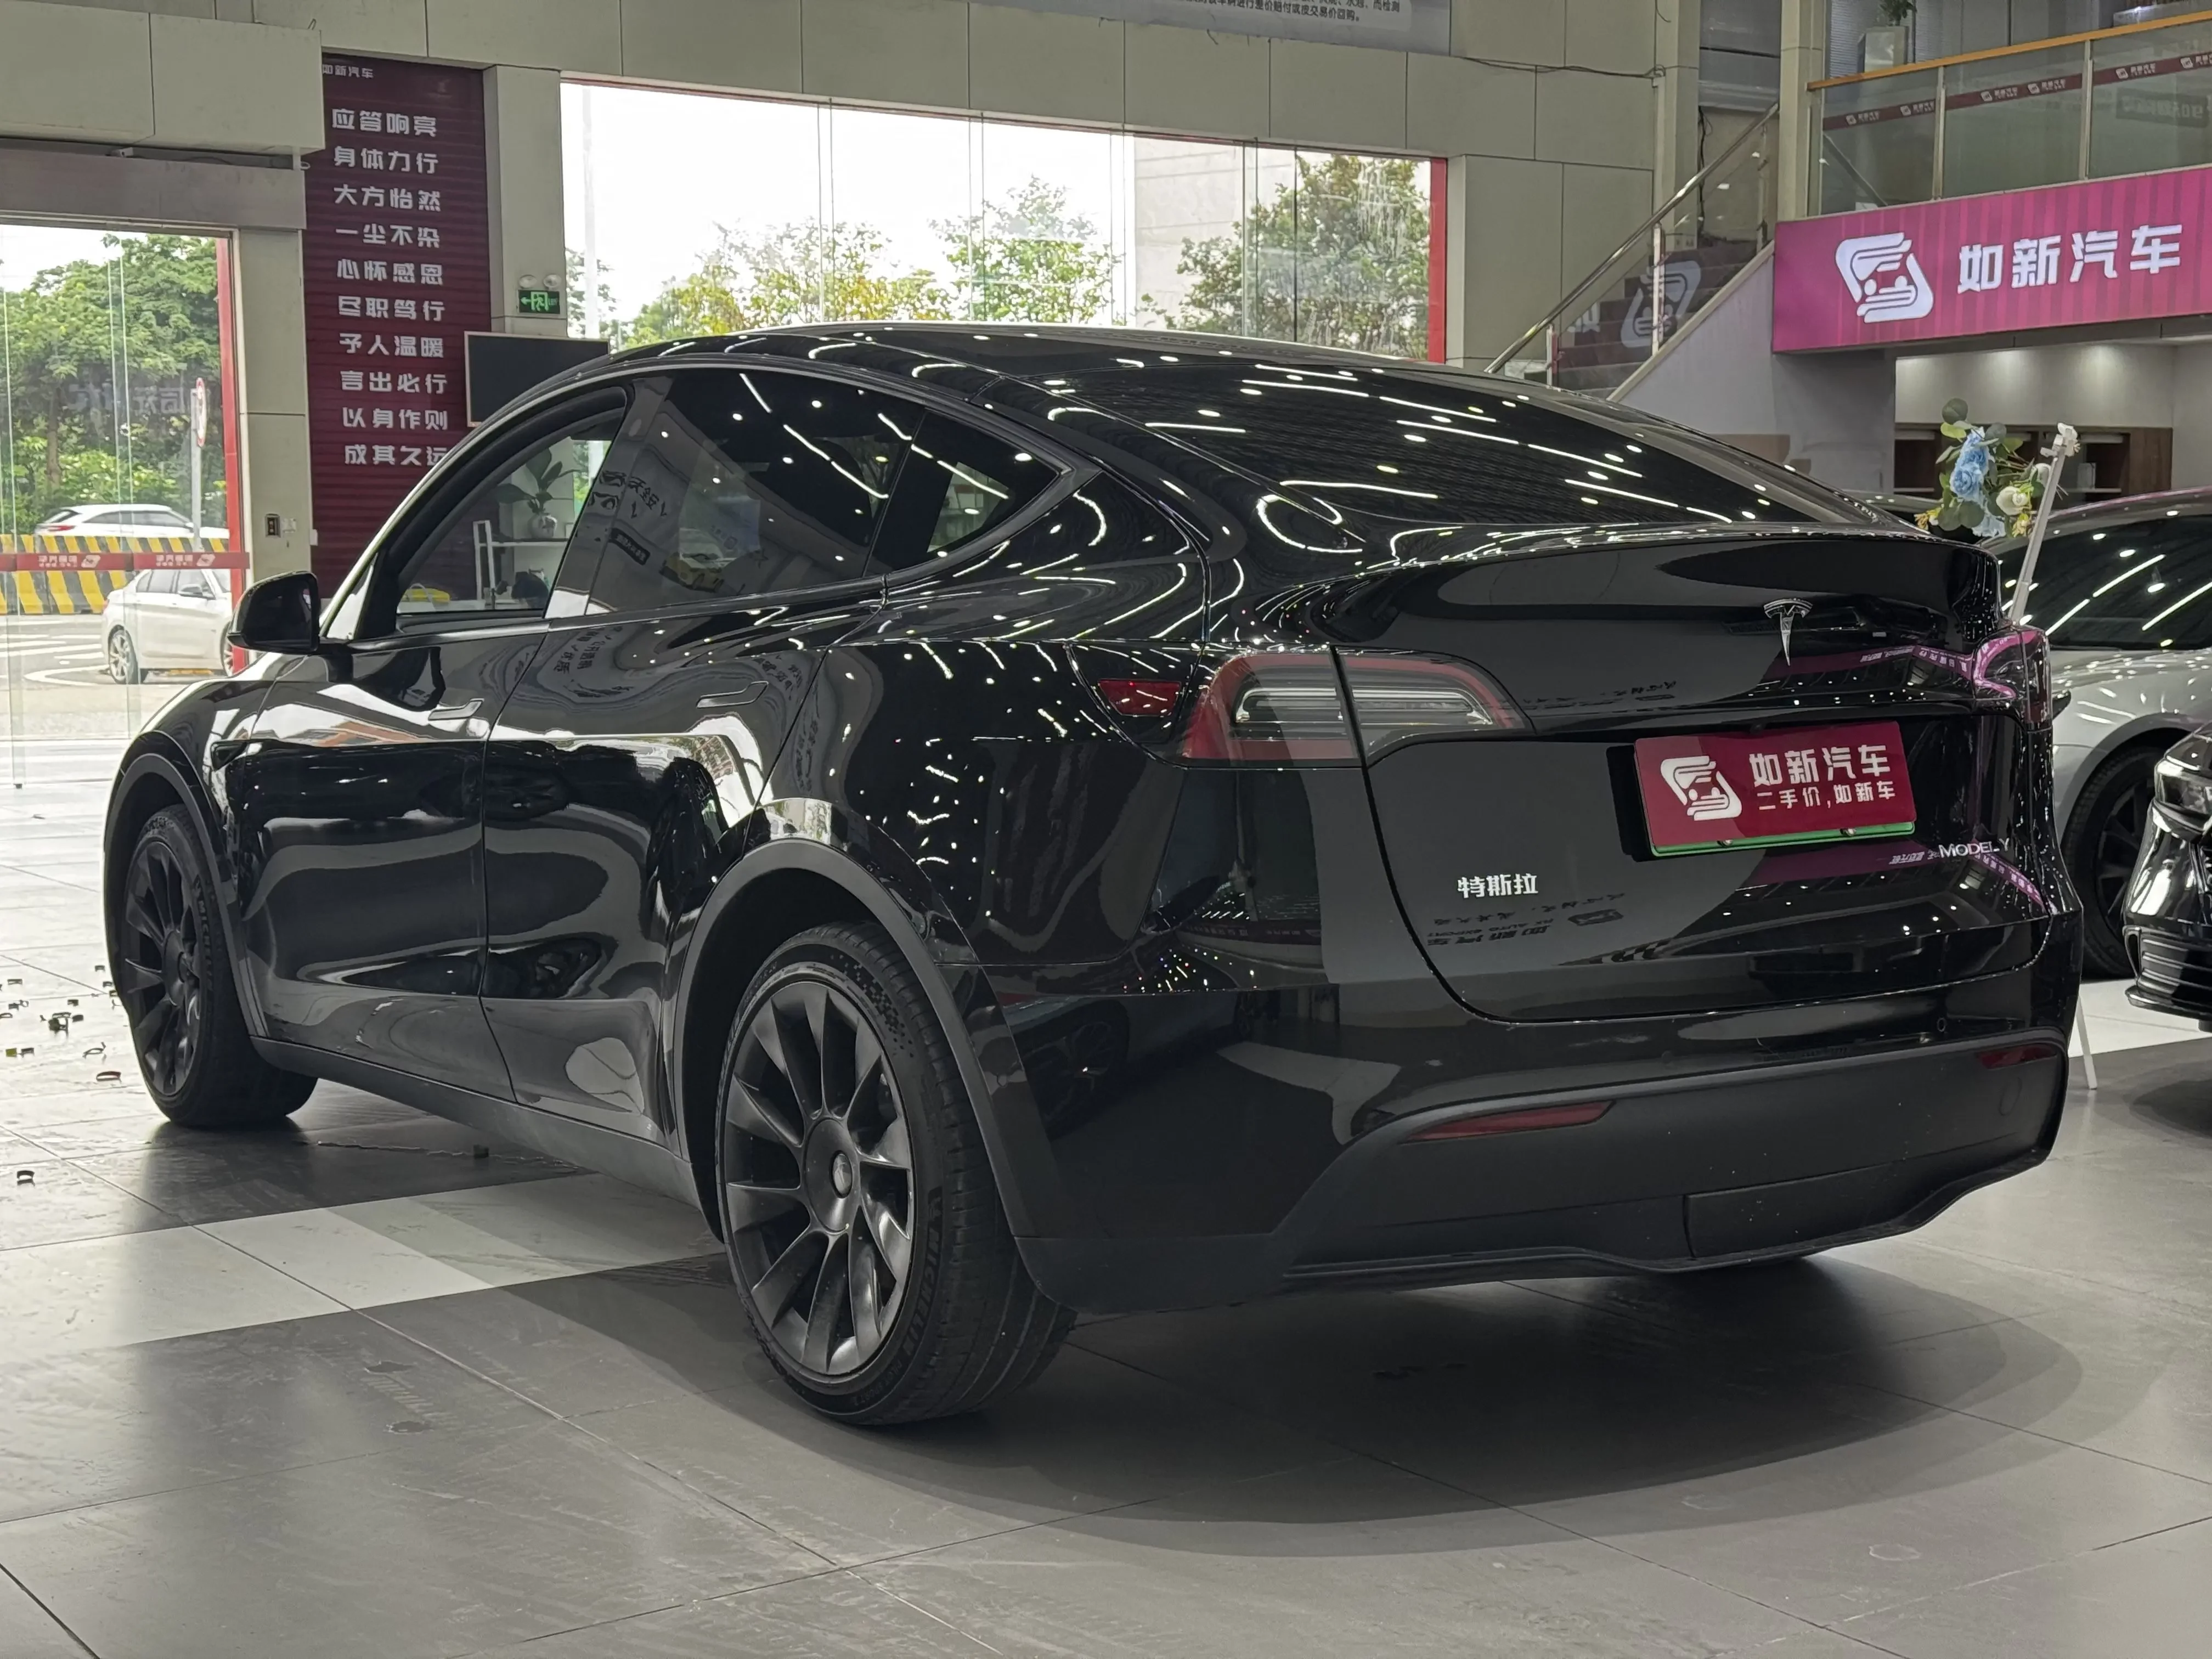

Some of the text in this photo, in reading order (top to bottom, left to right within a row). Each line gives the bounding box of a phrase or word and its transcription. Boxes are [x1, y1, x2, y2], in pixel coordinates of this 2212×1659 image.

[332, 109, 437, 137] 应答响亮
[334, 145, 439, 174] 身体力行
[334, 184, 441, 212] 大方怡然
[335, 223, 439, 248] 一尘不染
[337, 258, 443, 285] 心怀感恩
[1957, 224, 2182, 294] 如新汽车
[338, 295, 445, 321] 尽职笃行
[339, 332, 444, 358] 予人温暖
[340, 370, 448, 394] 言出必行
[342, 407, 448, 431] 以身作则
[1749, 744, 1891, 787] 如新汽车
[1938, 841, 2000, 858] MODEL
[1999, 838, 2010, 851] Y
[1457, 873, 1538, 899] 特斯拉
[903, 1227, 942, 1356] MICHELIN
